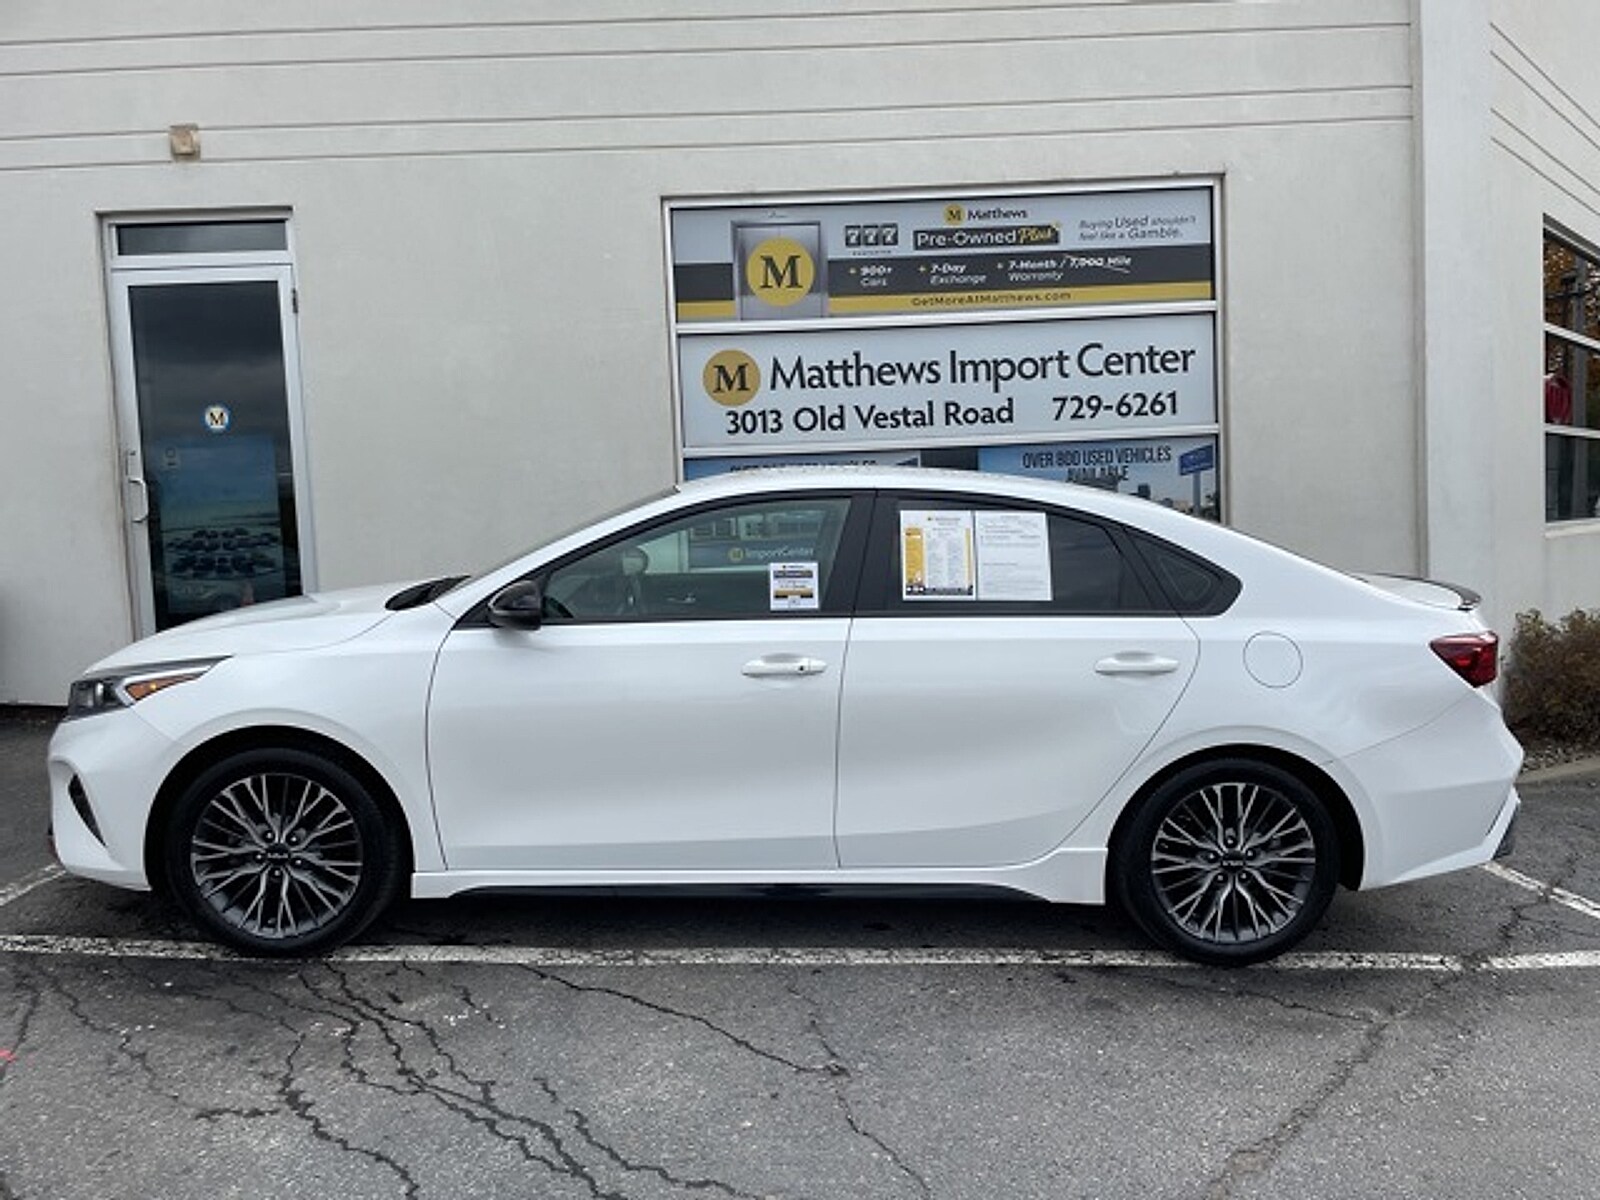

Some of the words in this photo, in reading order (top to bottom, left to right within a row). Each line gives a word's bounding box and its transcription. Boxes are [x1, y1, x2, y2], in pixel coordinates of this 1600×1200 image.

[967, 207, 1028, 221] Matthews
[1115, 215, 1148, 229] Used
[916, 230, 1017, 246] Pre-Owned
[759, 255, 803, 289] M
[1007, 258, 1057, 271] 7-Month
[929, 273, 987, 286] Exchange
[1008, 269, 1064, 283] Warranty
[712, 362, 752, 393] M
[769, 351, 942, 392] Matthews
[949, 349, 1070, 393] Import
[1077, 342, 1196, 377] Center
[725, 409, 784, 436] 3013
[793, 404, 846, 432] Old
[853, 400, 935, 430] Vestal
[944, 397, 1015, 426] Road
[1052, 390, 1178, 421] 729-6261
[1022, 452, 1054, 469] OVER
[1055, 450, 1081, 467] 800
[1082, 449, 1114, 466] USED
[1114, 445, 1172, 464] VEHICLES
